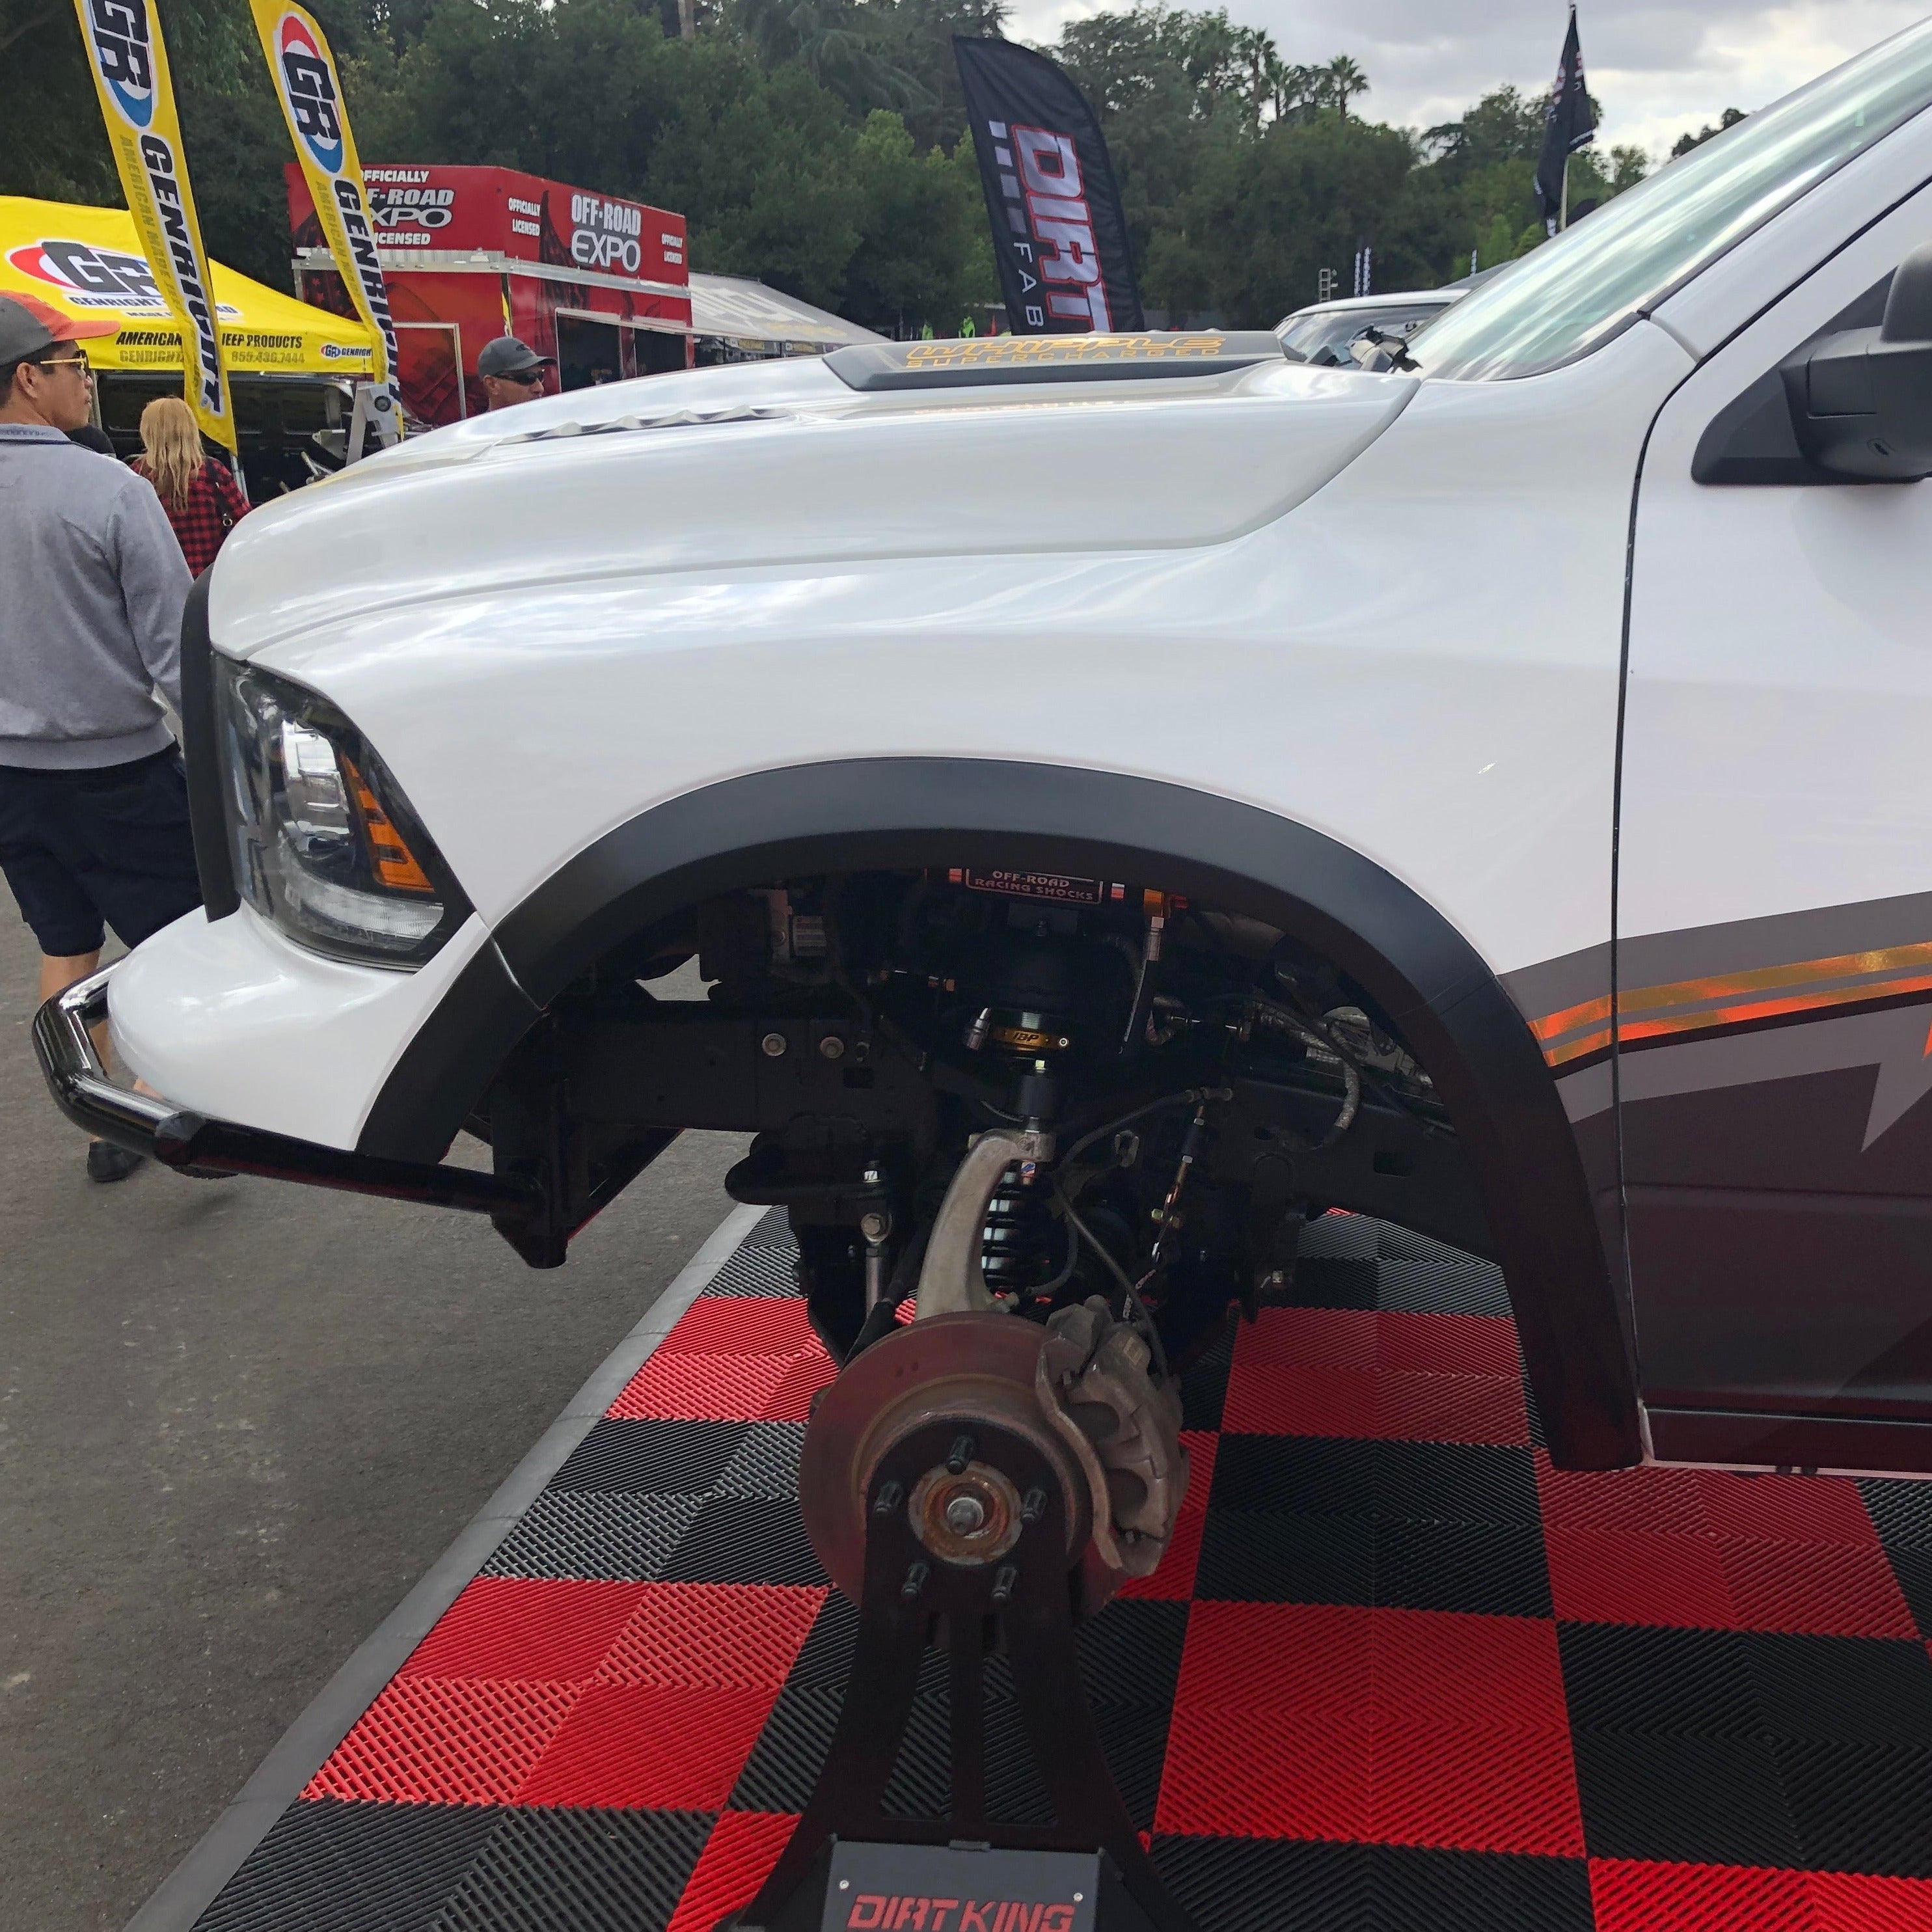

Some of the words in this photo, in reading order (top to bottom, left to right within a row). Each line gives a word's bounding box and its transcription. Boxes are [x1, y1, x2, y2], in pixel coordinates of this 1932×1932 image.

[92, 0, 152, 89] GR
[282, 52, 342, 140] GR
[361, 170, 429, 183] FFICIALLY
[366, 188, 455, 206] F-ROAD
[508, 197, 541, 217] OFFICIALLY
[370, 207, 452, 228] XPO
[571, 194, 641, 237] OFF-ROAD
[512, 219, 540, 236] LICENSED
[1011, 124, 1114, 333] DIRT
[374, 232, 431, 245] ICENSED
[571, 229, 641, 273] EXPO
[141, 135, 221, 413] GENRIGHT
[69, 297, 159, 306] GENRIGHT
[116, 331, 182, 346] AMERICAN
[247, 334, 303, 349] PRODUCTS
[342, 348, 372, 357] GENRIGH
[905, 348, 1220, 368] SUPERCHARGED
[975, 878, 1031, 892] RACING
[1036, 886, 1093, 901] SHOCKS
[992, 871, 1070, 888] OFF-ROAD
[847, 1894, 959, 1932] DIRT
[958, 1899, 1076, 1932] KING
